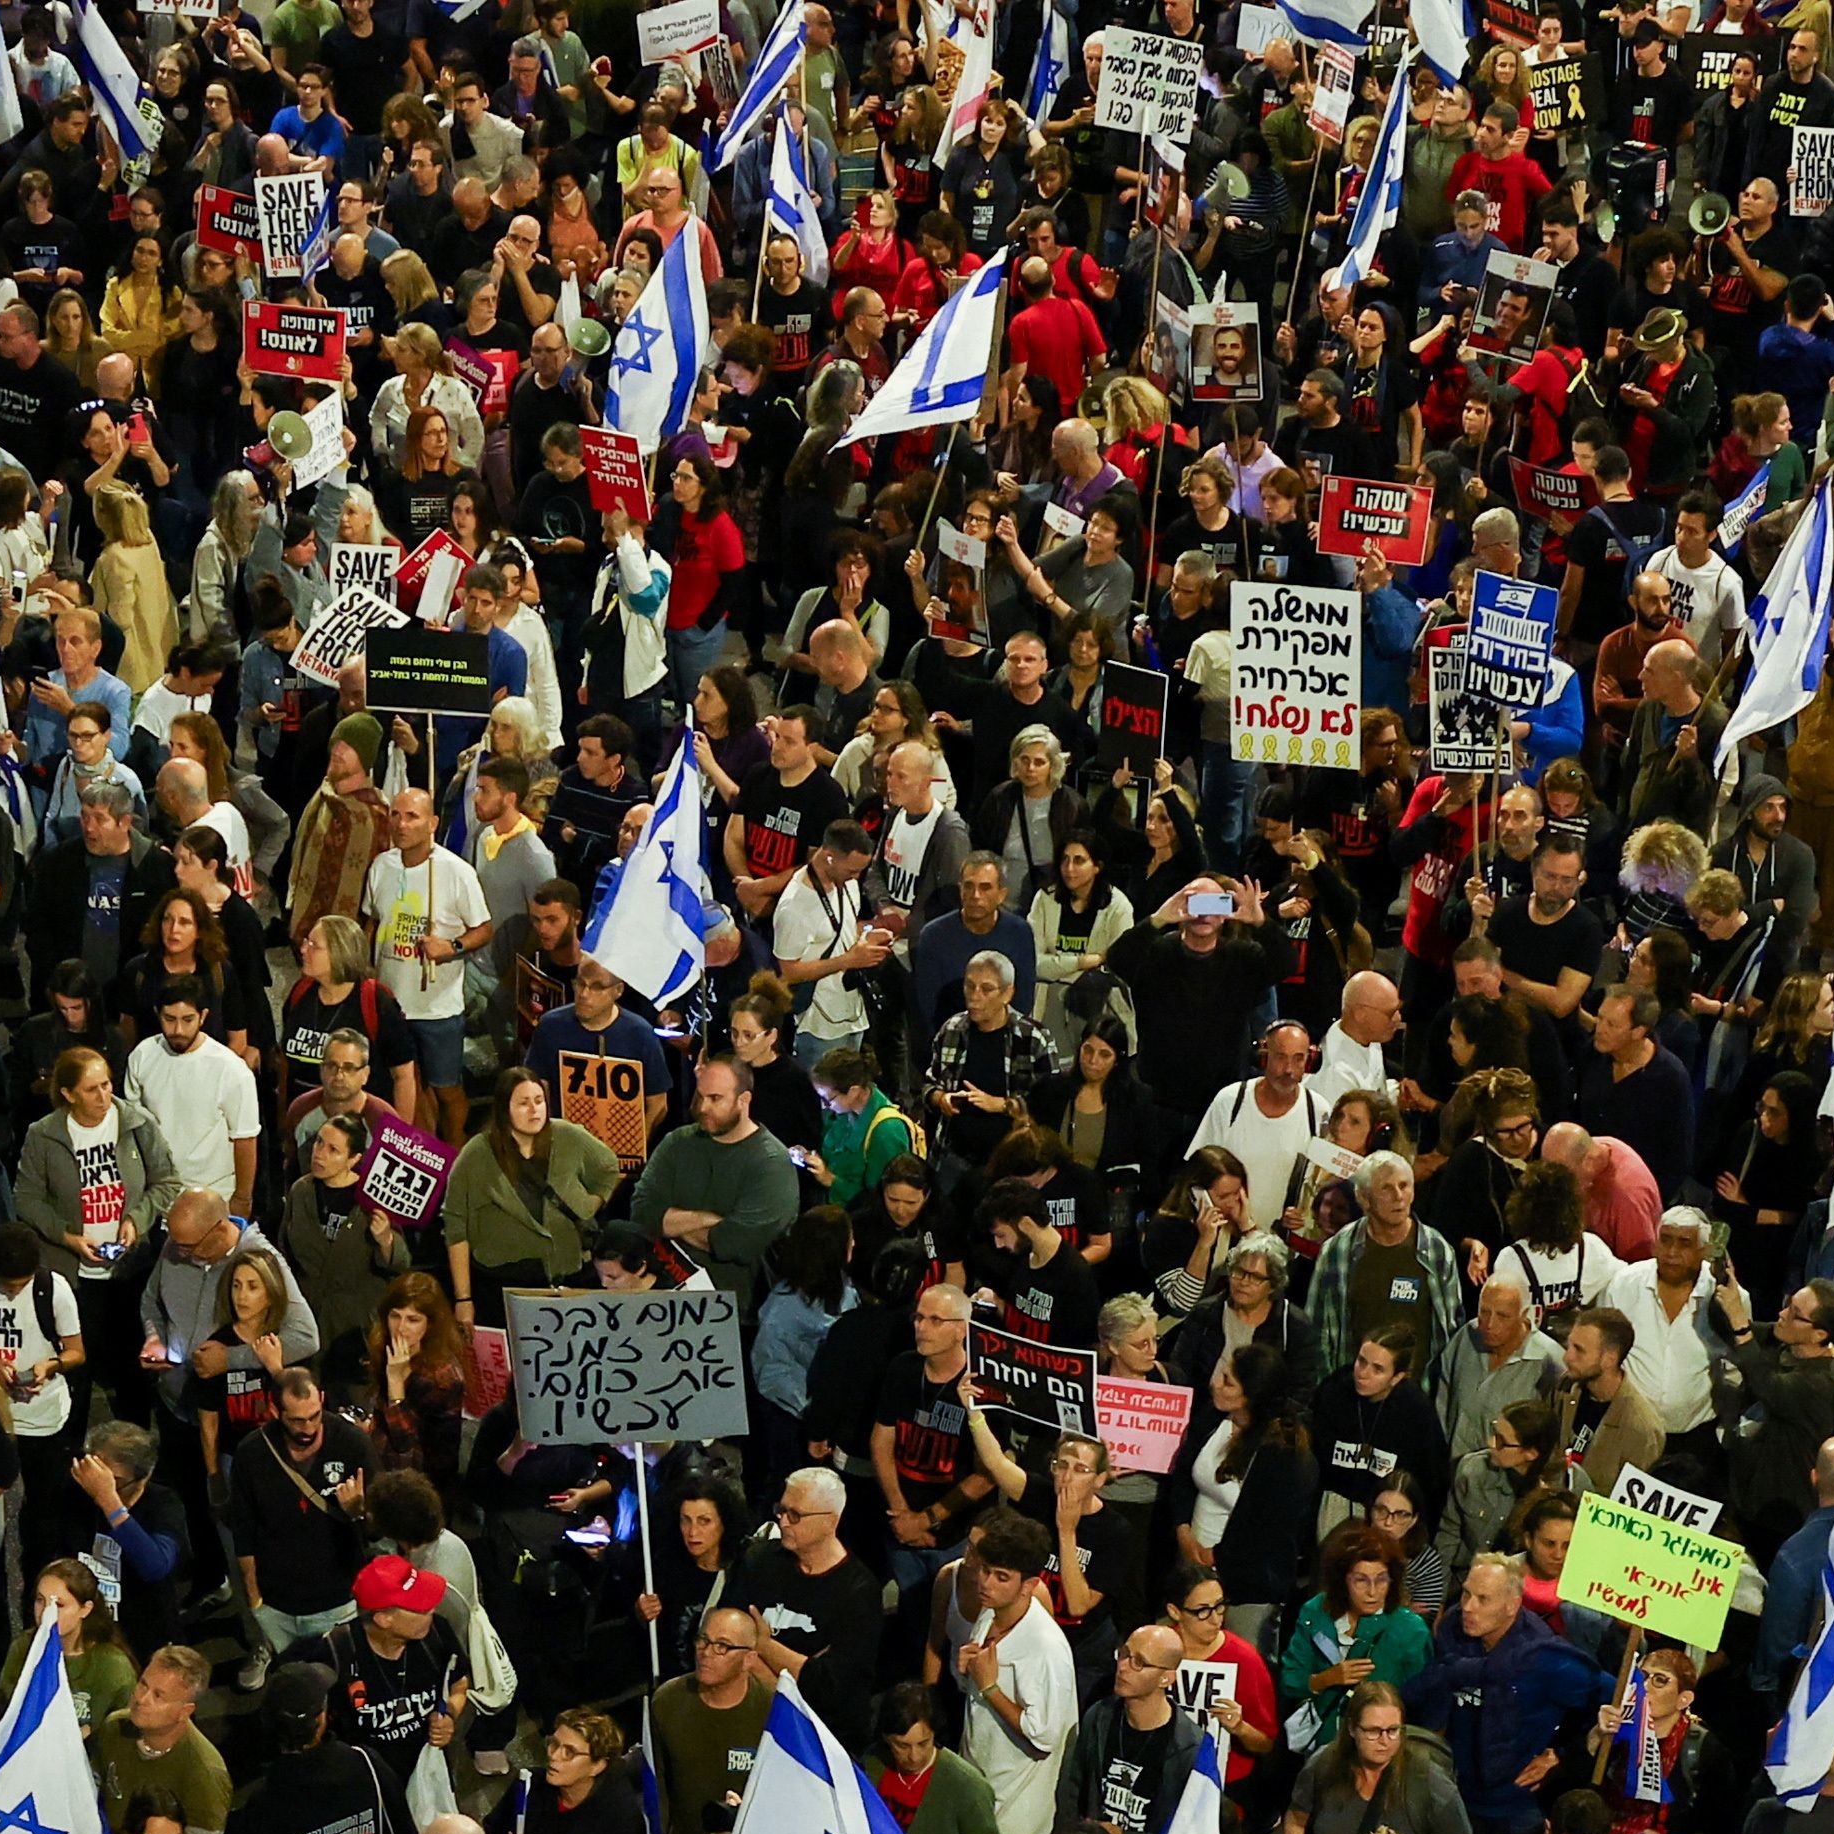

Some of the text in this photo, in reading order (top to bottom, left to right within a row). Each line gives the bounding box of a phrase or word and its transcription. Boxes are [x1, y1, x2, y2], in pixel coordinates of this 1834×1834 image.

[262, 180, 317, 210] SAVE
[264, 205, 320, 234] THEM
[280, 314, 335, 334] אין תרופה
[261, 329, 318, 354] לאונס!
[585, 444, 637, 463] שהפקיר
[603, 436, 617, 447] מי
[592, 472, 639, 489] להחזיר
[601, 460, 627, 472] חייב
[1535, 471, 1578, 493] עסקה
[1355, 486, 1408, 509] עסקה
[1531, 488, 1581, 509] עכשיו!
[1342, 508, 1406, 535] עכשיו!
[335, 550, 392, 580] SAVE
[339, 592, 398, 628] SAVE
[1248, 588, 1349, 626] ממשלה
[1236, 627, 1352, 665] מפקירת
[1467, 638, 1549, 672] בחירות
[389, 656, 412, 666] בעזה
[436, 657, 451, 669] שלי
[453, 659, 468, 670] הבן
[1468, 668, 1542, 705] עכשיו!
[1106, 696, 1161, 737] הצילו
[1233, 695, 1355, 735] לא נסלח!
[396, 922, 428, 935] THEM
[397, 912, 428, 925] BRING
[562, 1056, 641, 1101] 7.10
[76, 1145, 115, 1166] אתה
[378, 1153, 437, 1196] נגד
[78, 1184, 125, 1204] אתה
[365, 1184, 419, 1218] המוות
[370, 1173, 424, 1206] ממשלת
[81, 1203, 125, 1224] אשם
[636, 1296, 735, 1336] זמנם
[661, 1334, 724, 1364] גם
[977, 1331, 1083, 1377] כשהוא ילך
[644, 1363, 736, 1395] את
[978, 1356, 1085, 1402] הם יחזרו
[1626, 1478, 1708, 1530] SAVE
